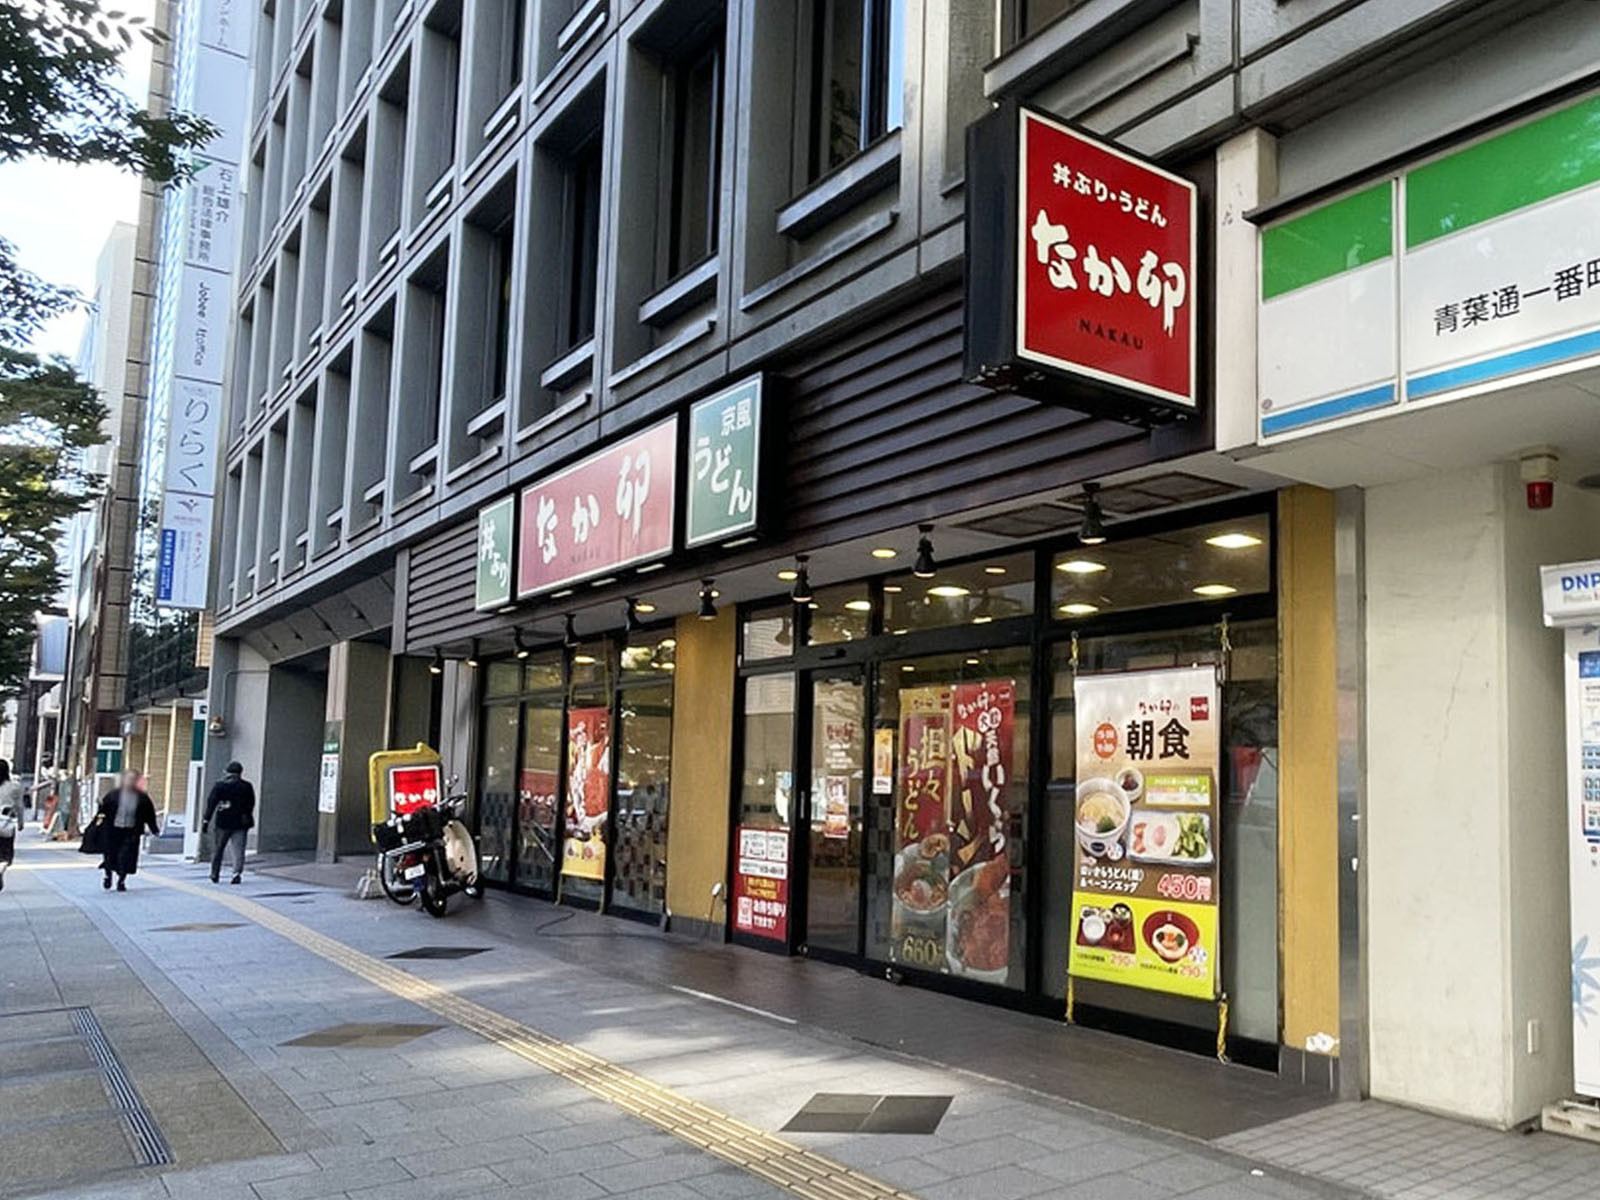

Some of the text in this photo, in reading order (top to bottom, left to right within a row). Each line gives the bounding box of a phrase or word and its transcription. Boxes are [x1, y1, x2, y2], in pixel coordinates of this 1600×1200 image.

[1030, 208, 1186, 339] なか卯
[1079, 319, 1144, 350] NAKAU
[720, 399, 752, 436] 京風
[695, 436, 752, 516] うどん
[536, 451, 651, 565] なか卯
[1125, 718, 1190, 761] 朝食
[904, 747, 920, 840] うどん
[1157, 874, 1212, 900] 450円
